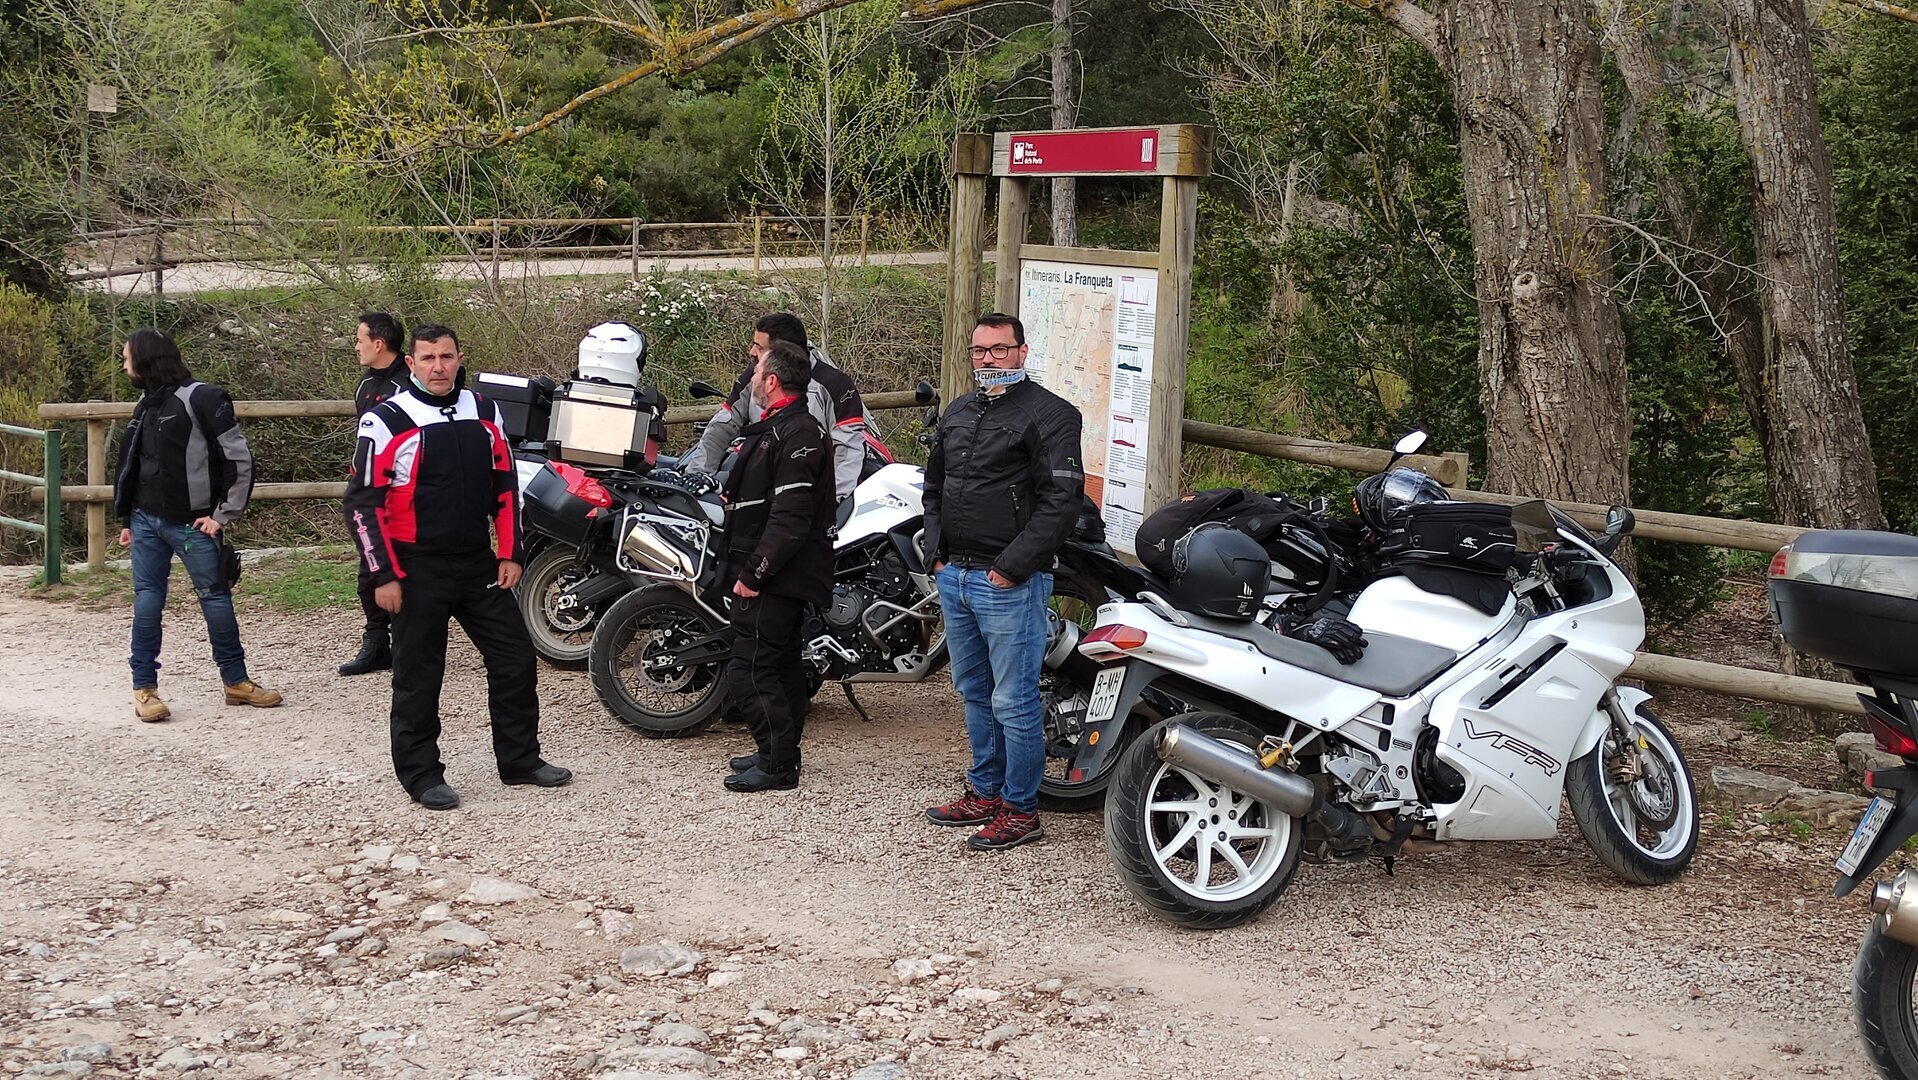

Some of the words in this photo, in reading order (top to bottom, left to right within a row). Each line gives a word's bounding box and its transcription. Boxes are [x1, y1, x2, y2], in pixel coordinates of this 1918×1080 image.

[1064, 271, 1073, 284] La
[1075, 272, 1113, 290] Franqueta
[981, 371, 1008, 380] CURSA
[1090, 694, 1114, 718] 4017
[1463, 717, 1562, 778] VFR
